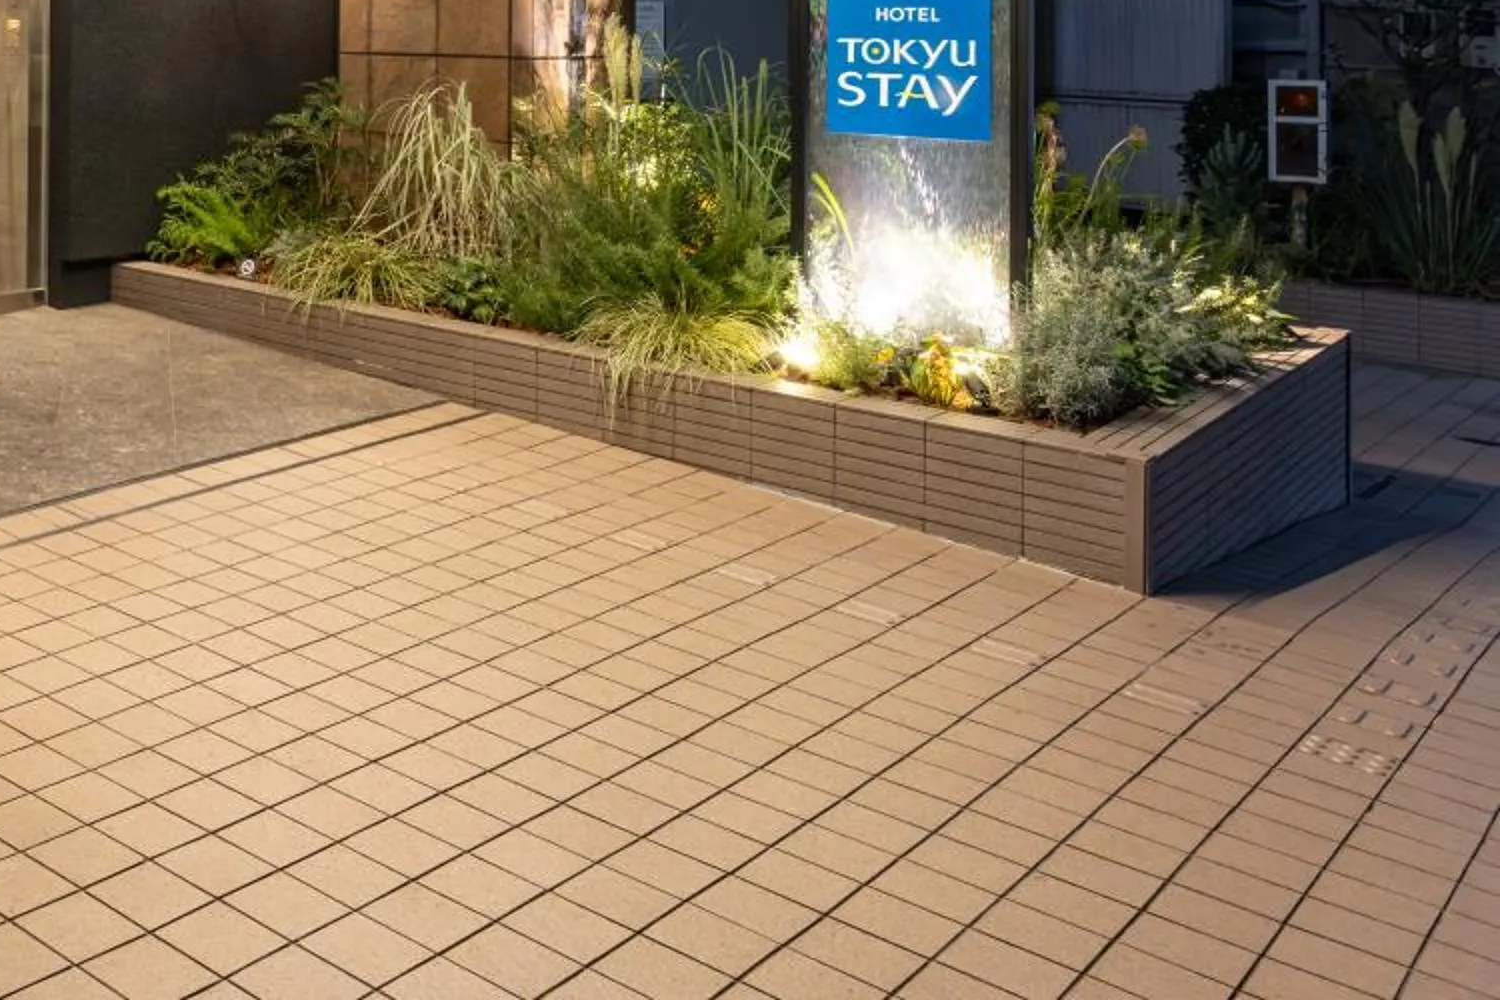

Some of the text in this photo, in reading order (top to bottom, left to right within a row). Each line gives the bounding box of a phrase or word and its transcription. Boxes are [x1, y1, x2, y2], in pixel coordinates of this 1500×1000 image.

[875, 7, 941, 23] HOTEL
[836, 37, 977, 69] TOKYU
[836, 71, 979, 117] STAY
